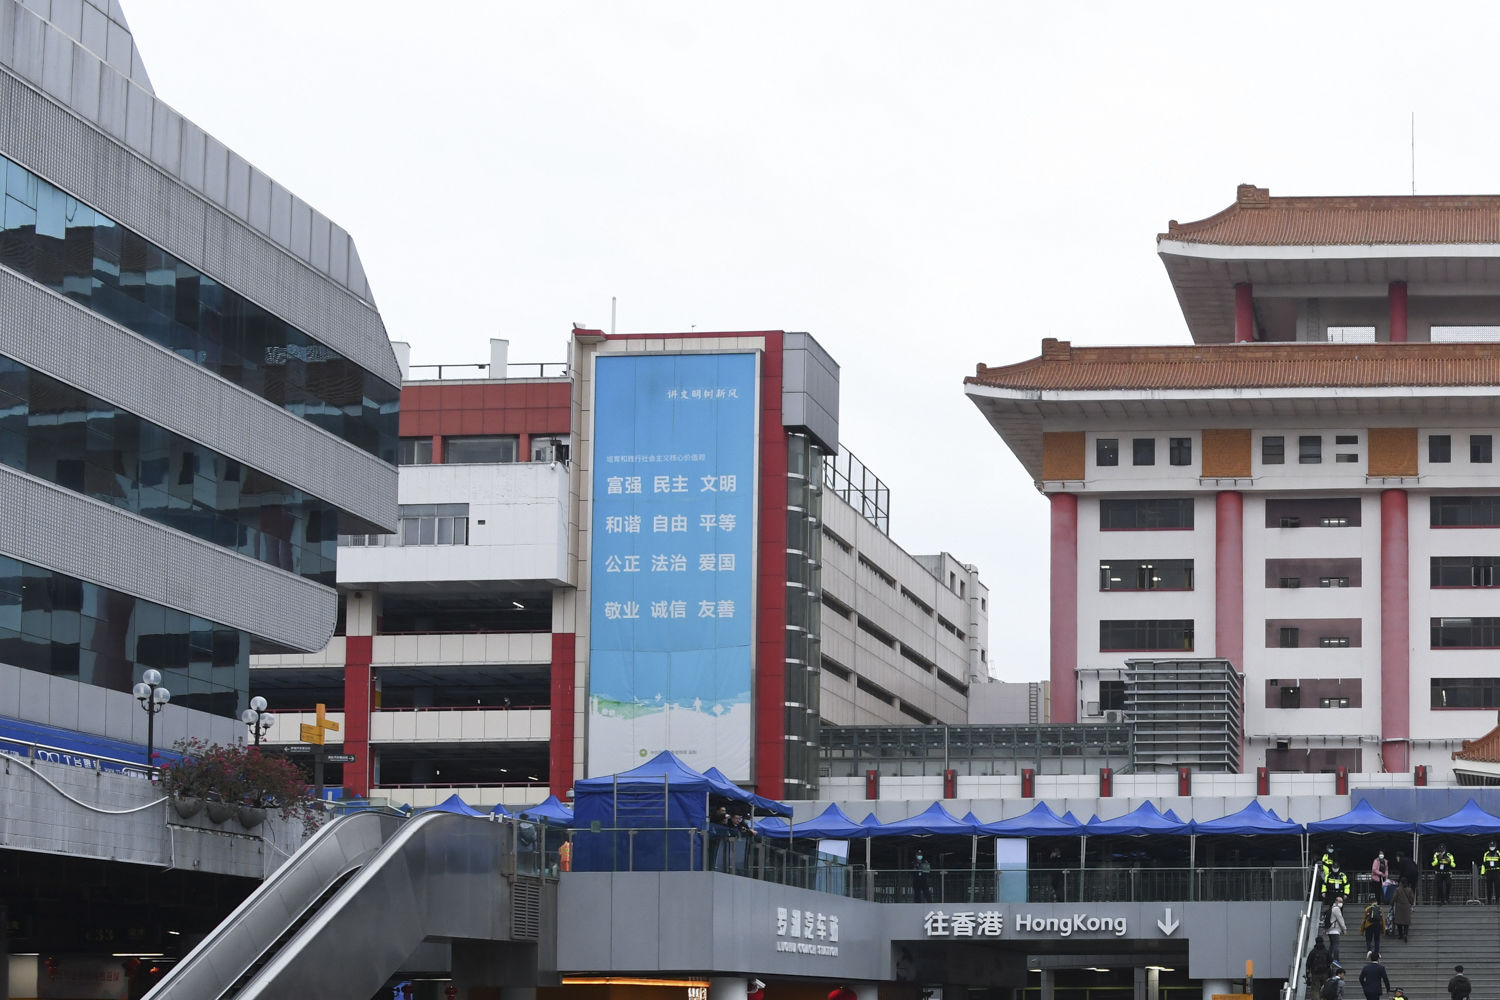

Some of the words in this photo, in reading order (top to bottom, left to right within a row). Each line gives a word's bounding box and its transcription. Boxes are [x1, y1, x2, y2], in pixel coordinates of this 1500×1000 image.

[667, 388, 739, 400] 讲文明树新风
[607, 476, 642, 494] 富强
[653, 475, 688, 493] 民主
[700, 475, 737, 493] 文明
[605, 515, 642, 534] 和谐
[652, 515, 688, 533] 自由
[699, 514, 737, 532] 平等
[604, 555, 641, 573] 公正
[651, 554, 687, 572] 法治
[698, 553, 736, 571] 爱国
[604, 601, 640, 620] 敬业
[651, 601, 687, 619] 诚信
[698, 600, 735, 618] 友善
[924, 911, 1004, 937] 往香港
[1015, 913, 1127, 937] HongKong
